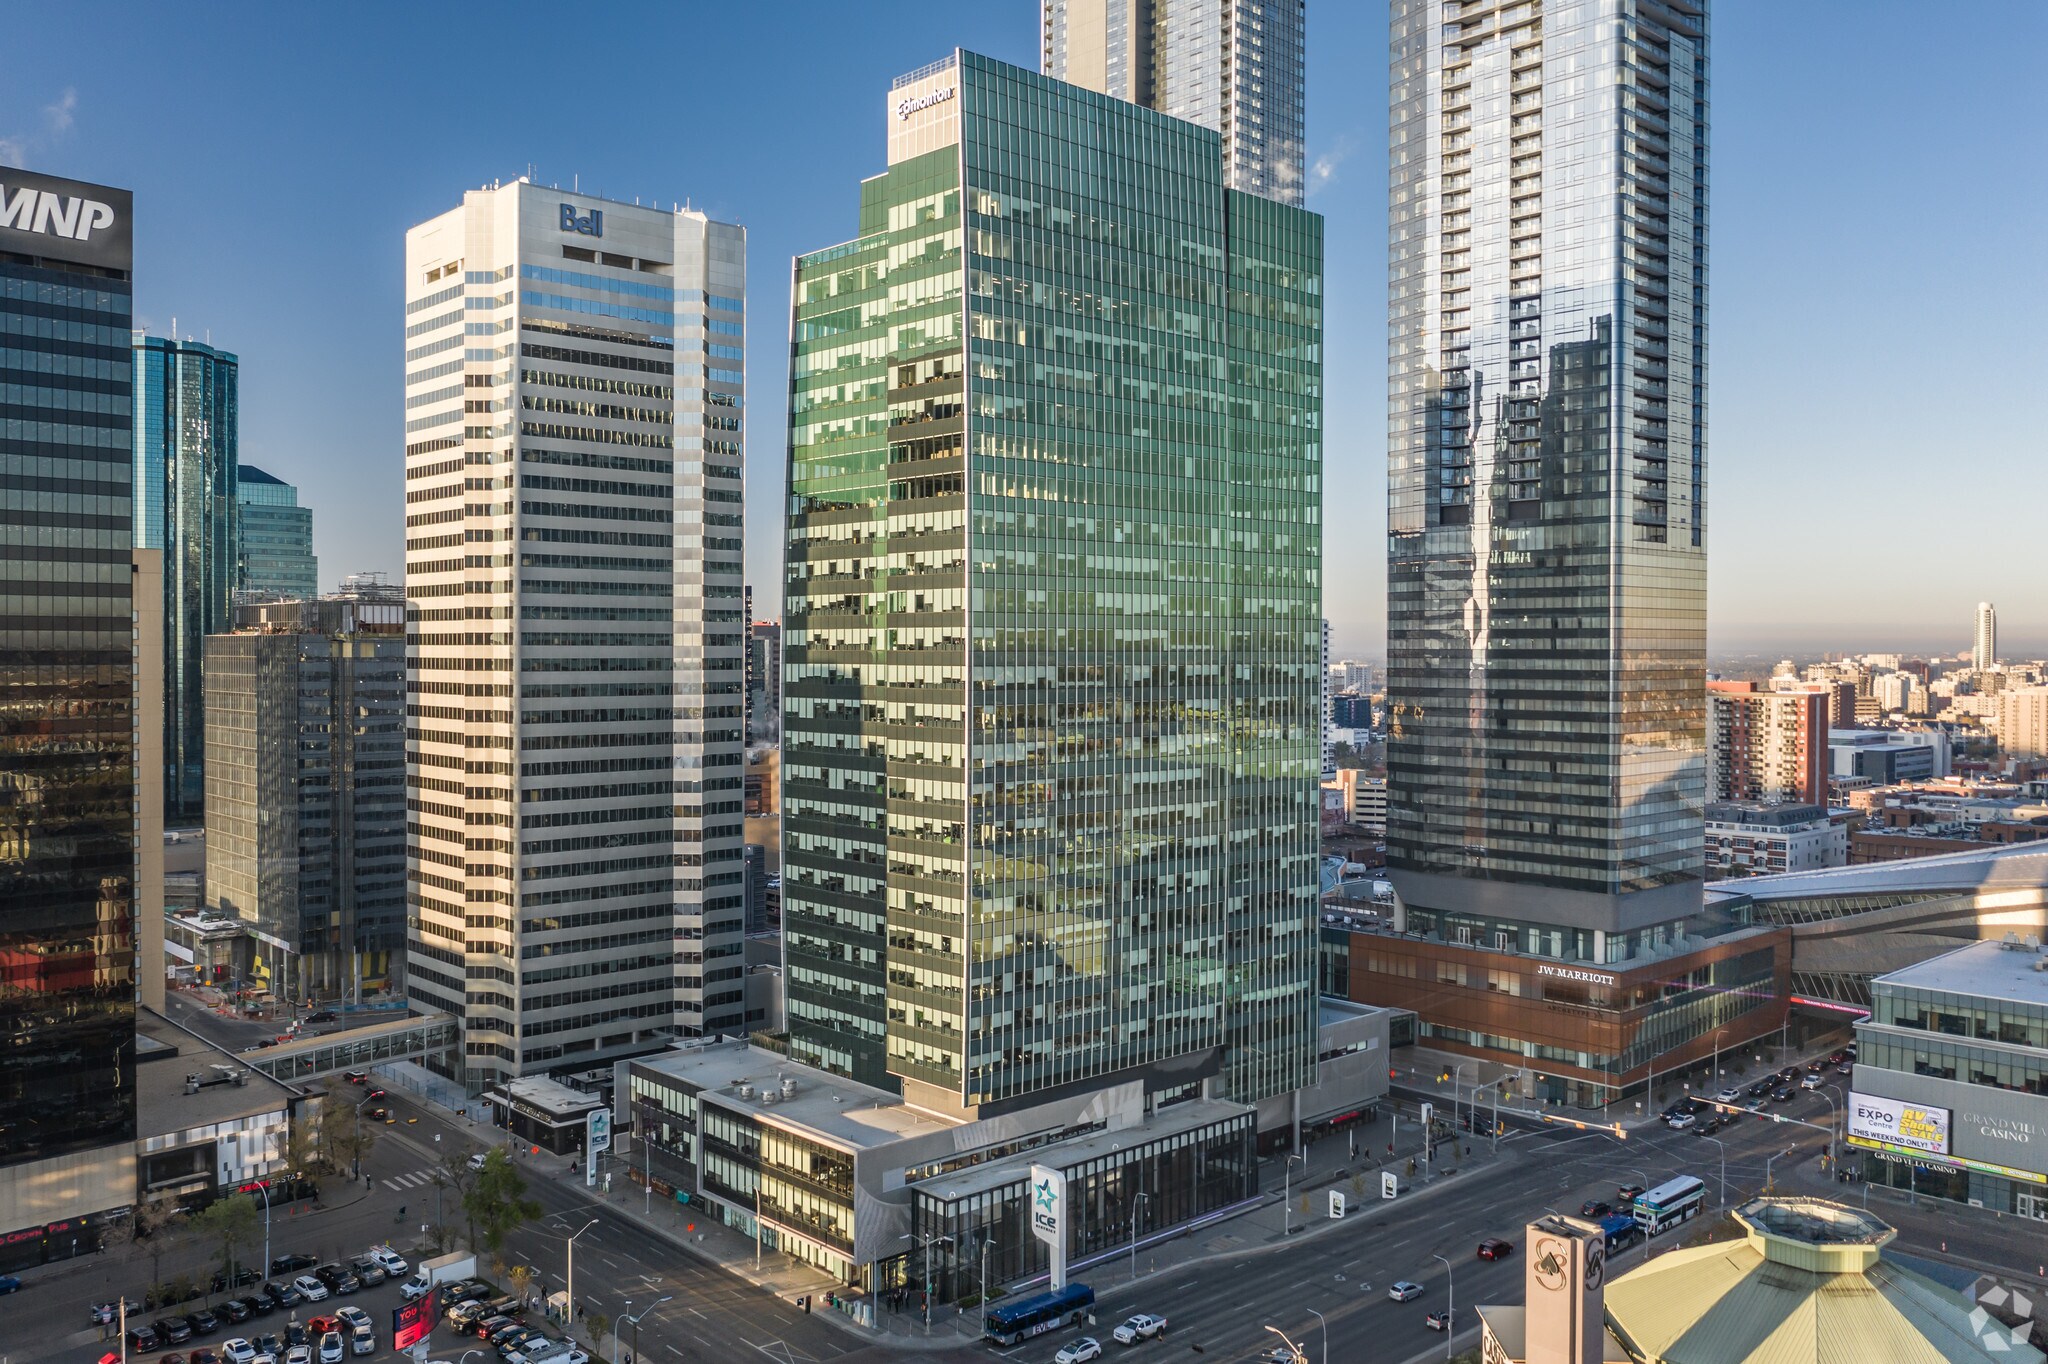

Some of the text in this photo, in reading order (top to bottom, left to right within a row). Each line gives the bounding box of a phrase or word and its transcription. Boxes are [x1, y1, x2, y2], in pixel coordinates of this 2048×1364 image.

[896, 88, 954, 121] Edmonton
[0, 184, 115, 240] MNP
[560, 203, 603, 238] Bell
[1538, 965, 1614, 985] JW MARRIOTT
[1858, 1108, 1893, 1122] EXPO
[1902, 1109, 1927, 1121] RV
[1963, 1113, 2008, 1128] GRAND
[1868, 1120, 1893, 1129] Centre
[1852, 1128, 1869, 1136] THIS
[1870, 1131, 1905, 1144] WEEKEND
[1906, 1139, 1928, 1148] ONLY!
[1980, 1126, 2029, 1143] CASINO
[1874, 1152, 1901, 1163] GRAND
[1903, 1158, 1926, 1168] VILA
[1926, 1163, 1957, 1174] CASINO
[399, 1307, 417, 1320] YOU
